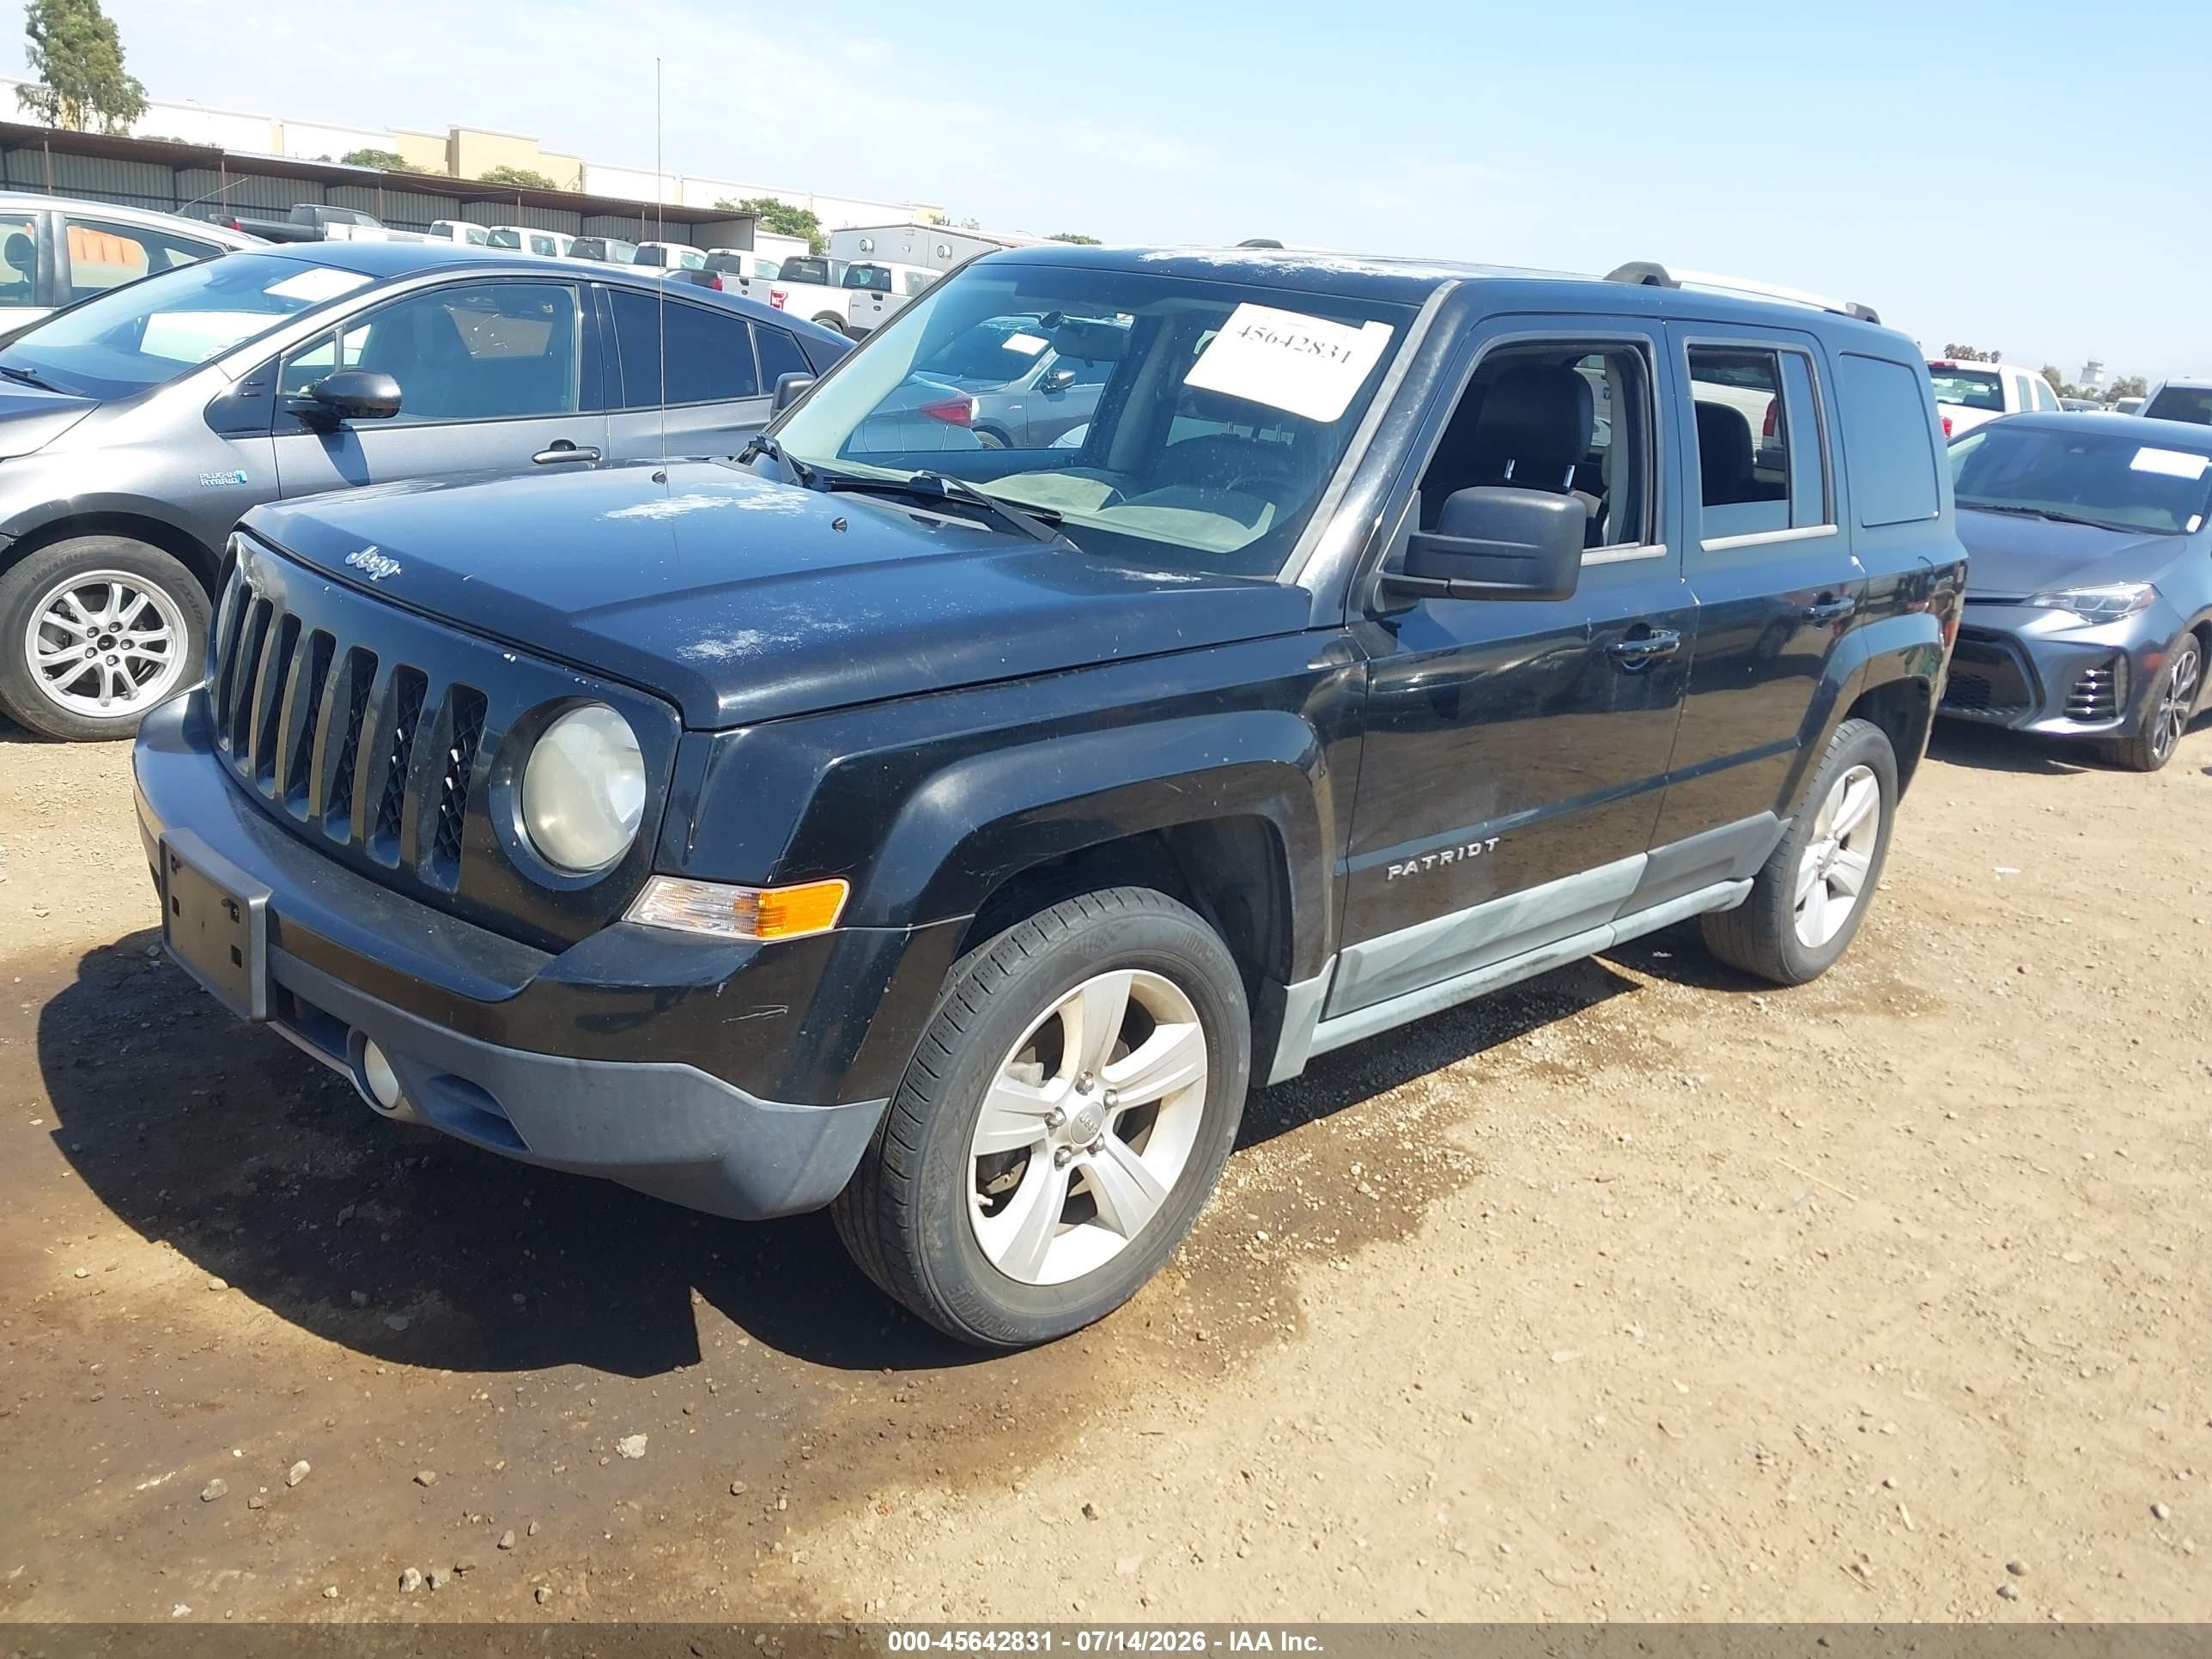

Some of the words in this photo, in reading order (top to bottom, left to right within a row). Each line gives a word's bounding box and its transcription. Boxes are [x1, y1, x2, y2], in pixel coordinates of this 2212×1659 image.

[1237, 325, 1352, 364] 45642831
[344, 545, 401, 581] Jeep
[1387, 836, 1500, 881] PATRIOT
